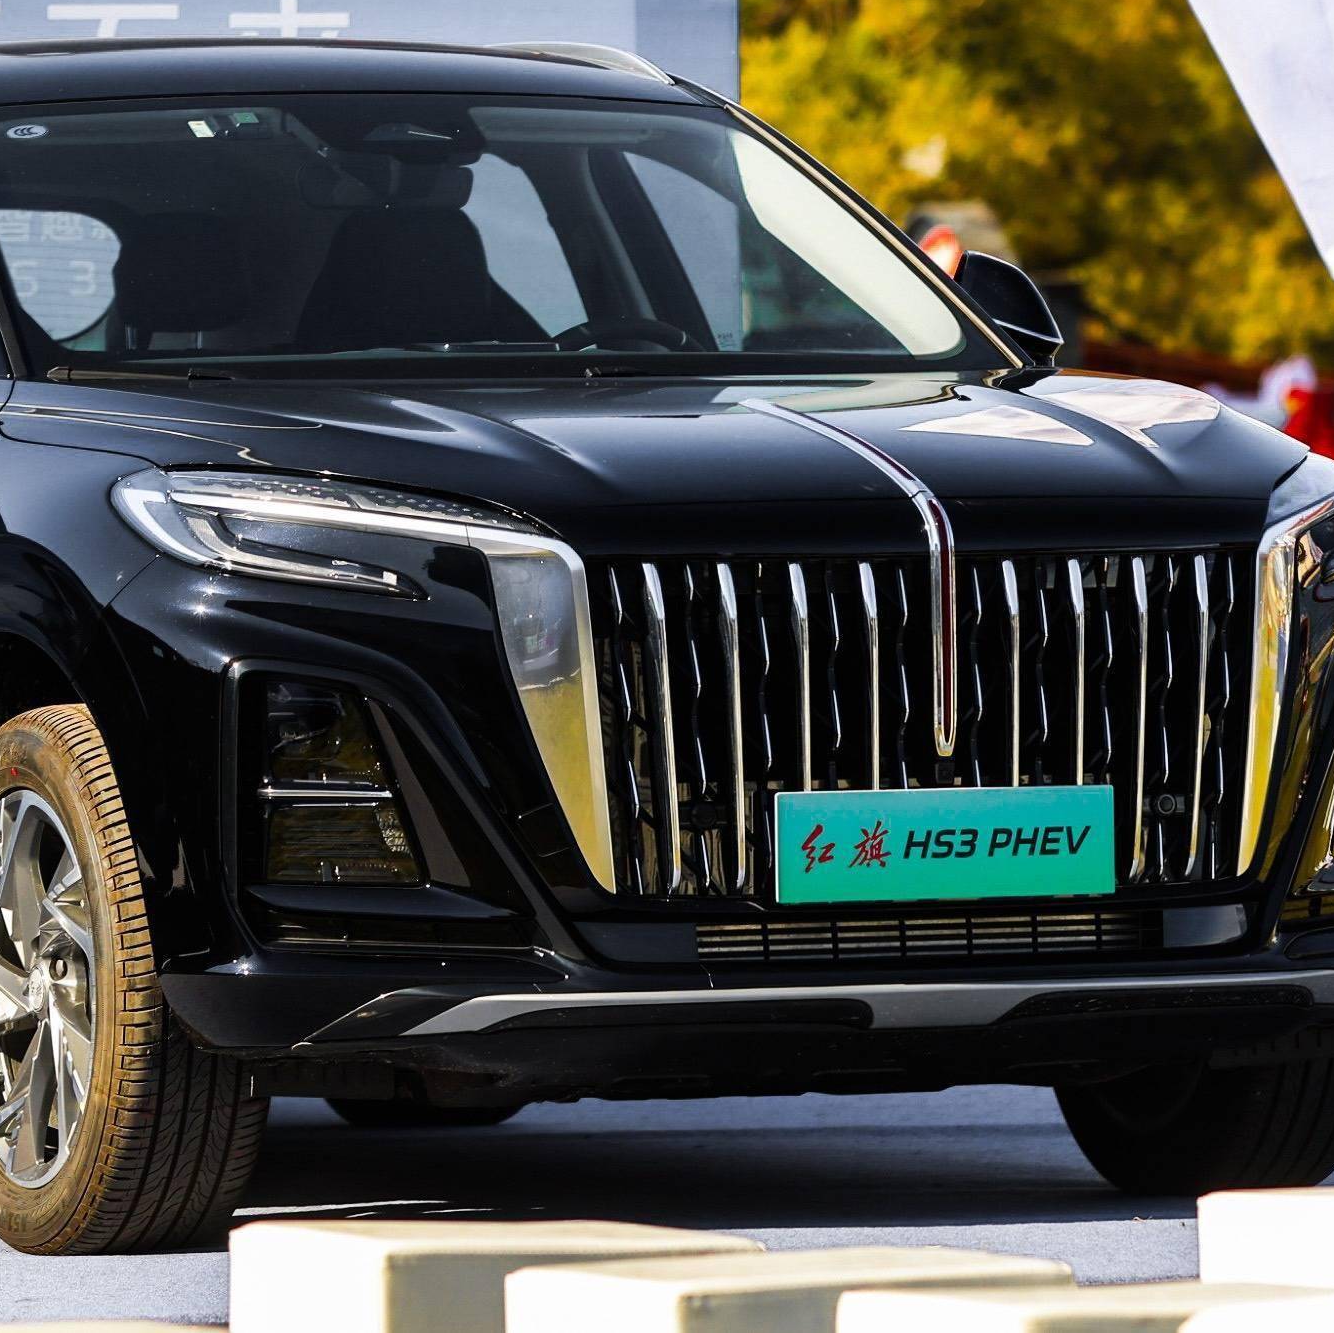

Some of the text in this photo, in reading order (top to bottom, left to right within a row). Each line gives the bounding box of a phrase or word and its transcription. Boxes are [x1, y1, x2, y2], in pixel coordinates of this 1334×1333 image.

[800, 820, 1091, 873] 红旗 HS3 PHEV
